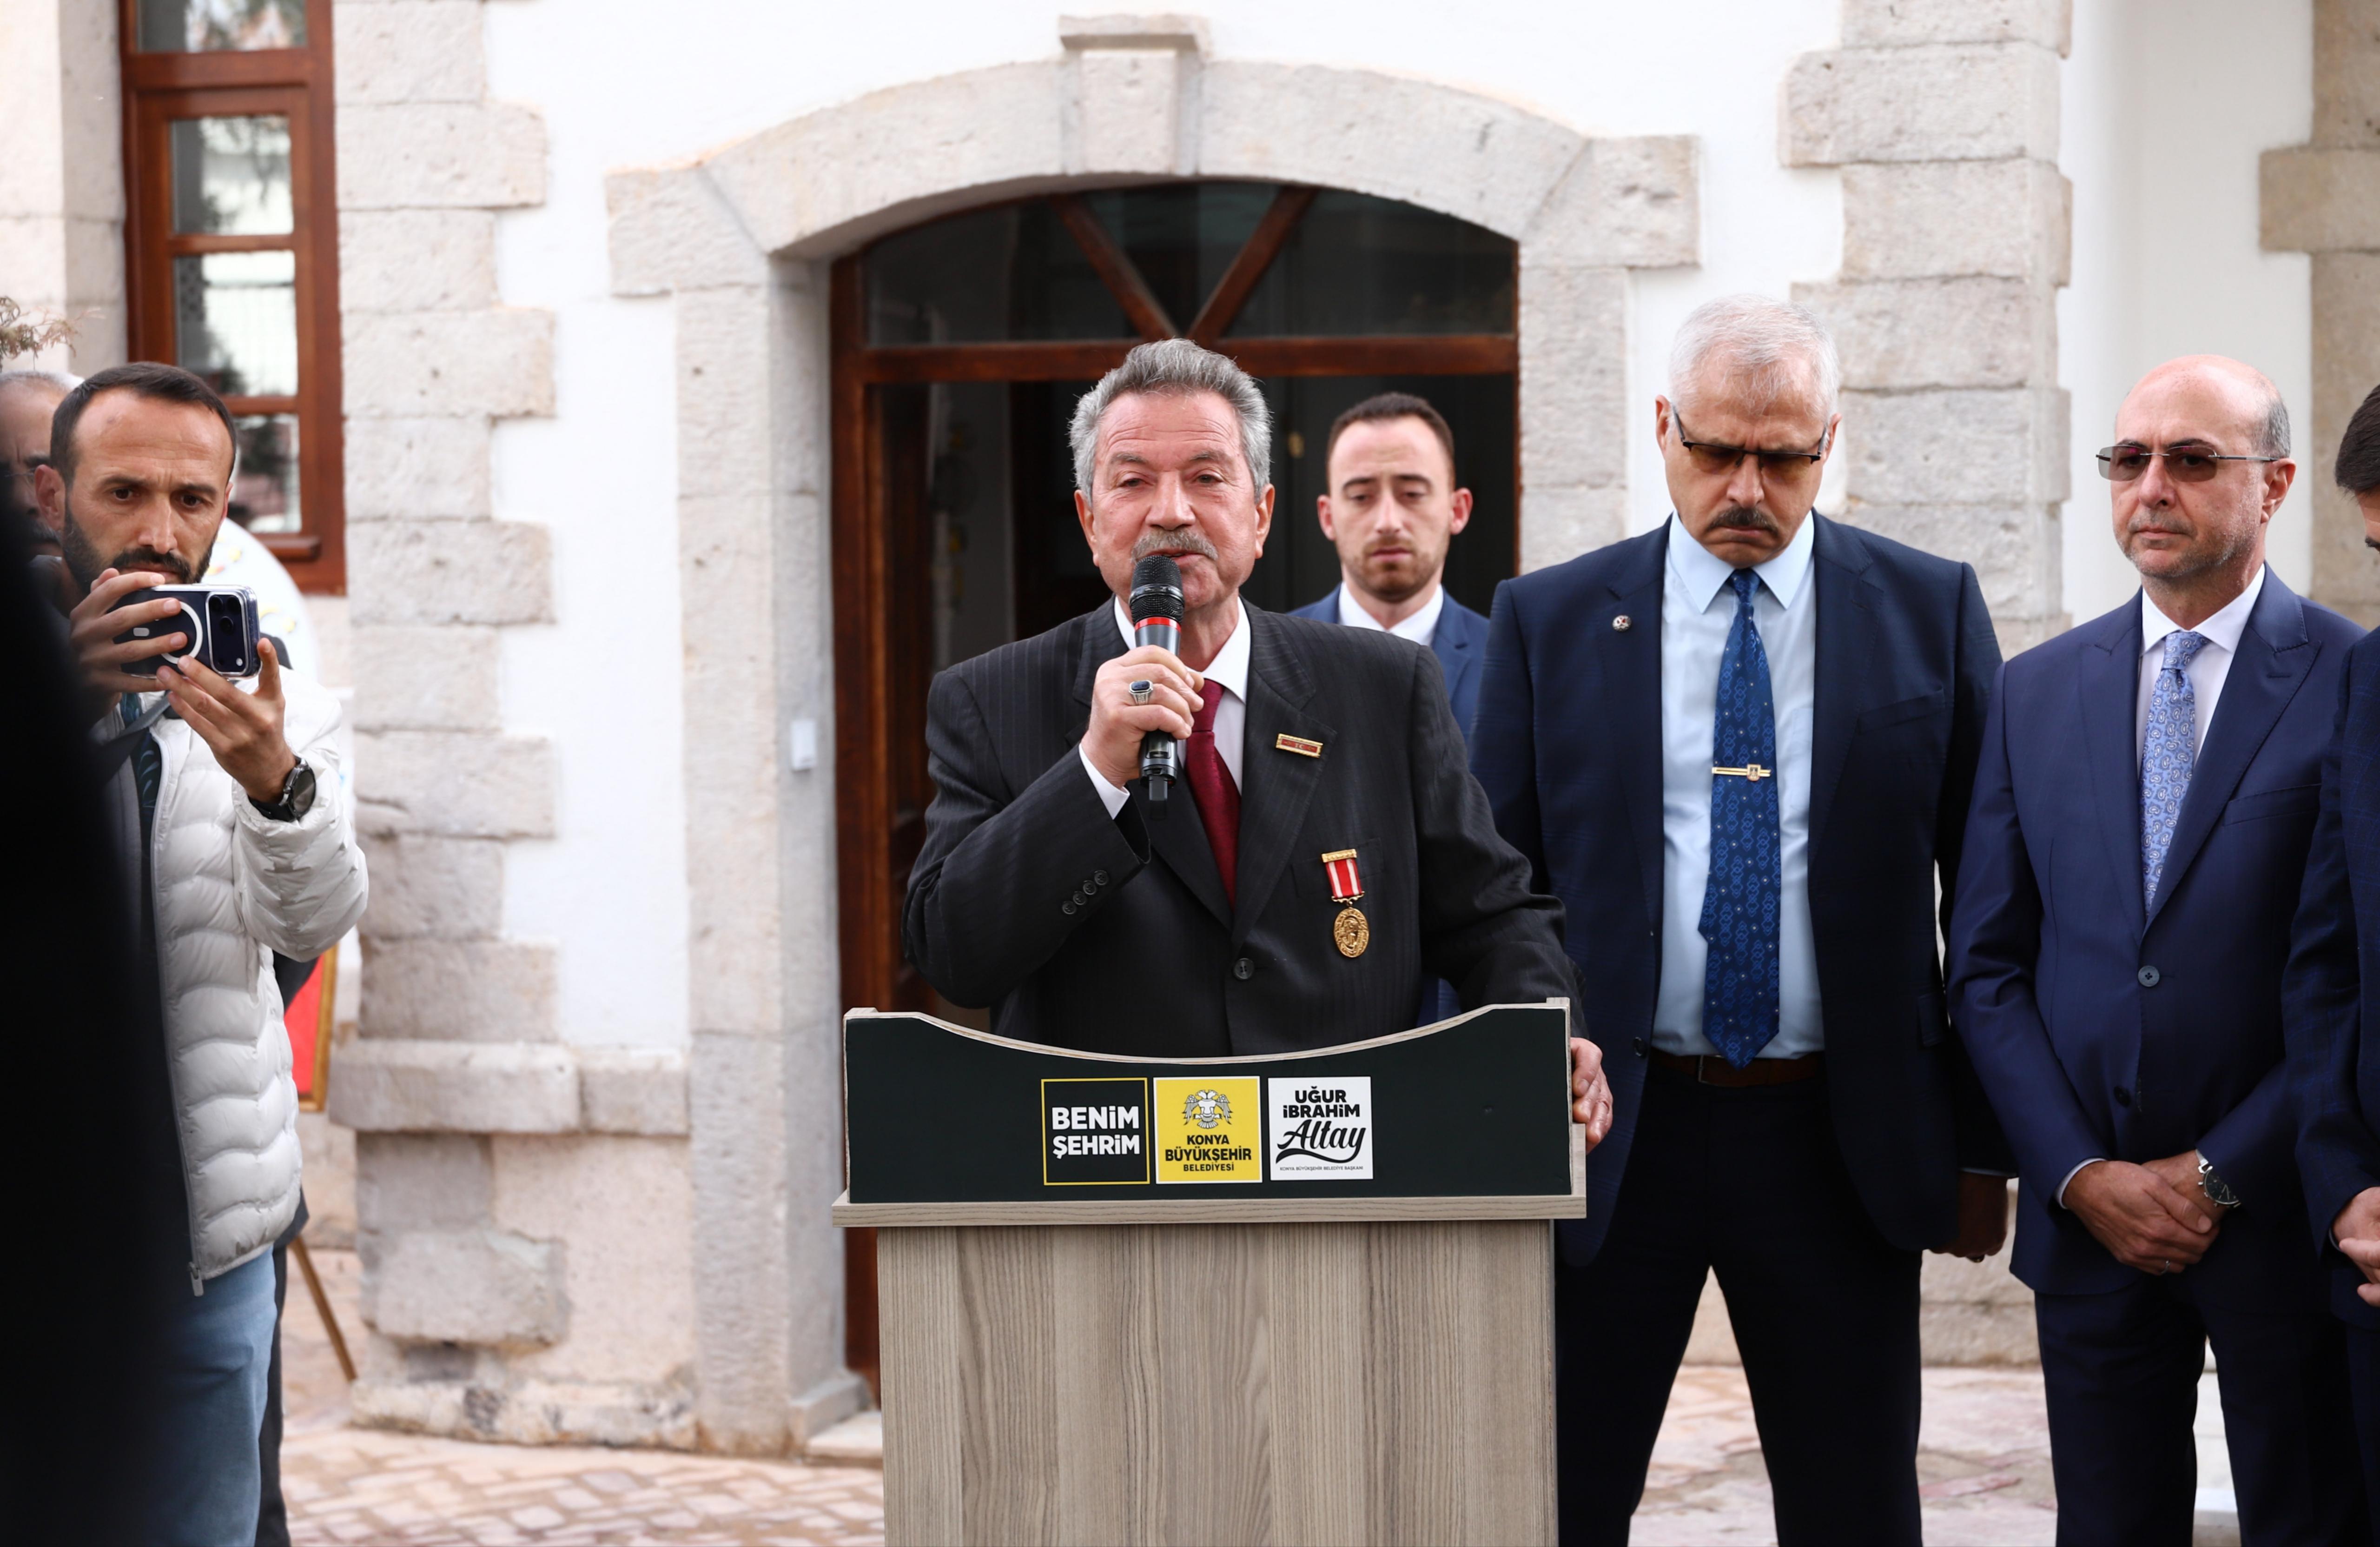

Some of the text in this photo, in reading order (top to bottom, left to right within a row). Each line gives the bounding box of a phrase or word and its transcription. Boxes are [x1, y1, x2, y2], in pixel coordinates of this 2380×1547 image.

[1295, 1086, 1347, 1103] UĞUR
[1187, 1135, 1230, 1145] KONYA
[1276, 1119, 1366, 1164] Altay
[1165, 1146, 1251, 1162] BÜYÜKŞEHİR
[1183, 1162, 1234, 1171] BELEDİYESİ
